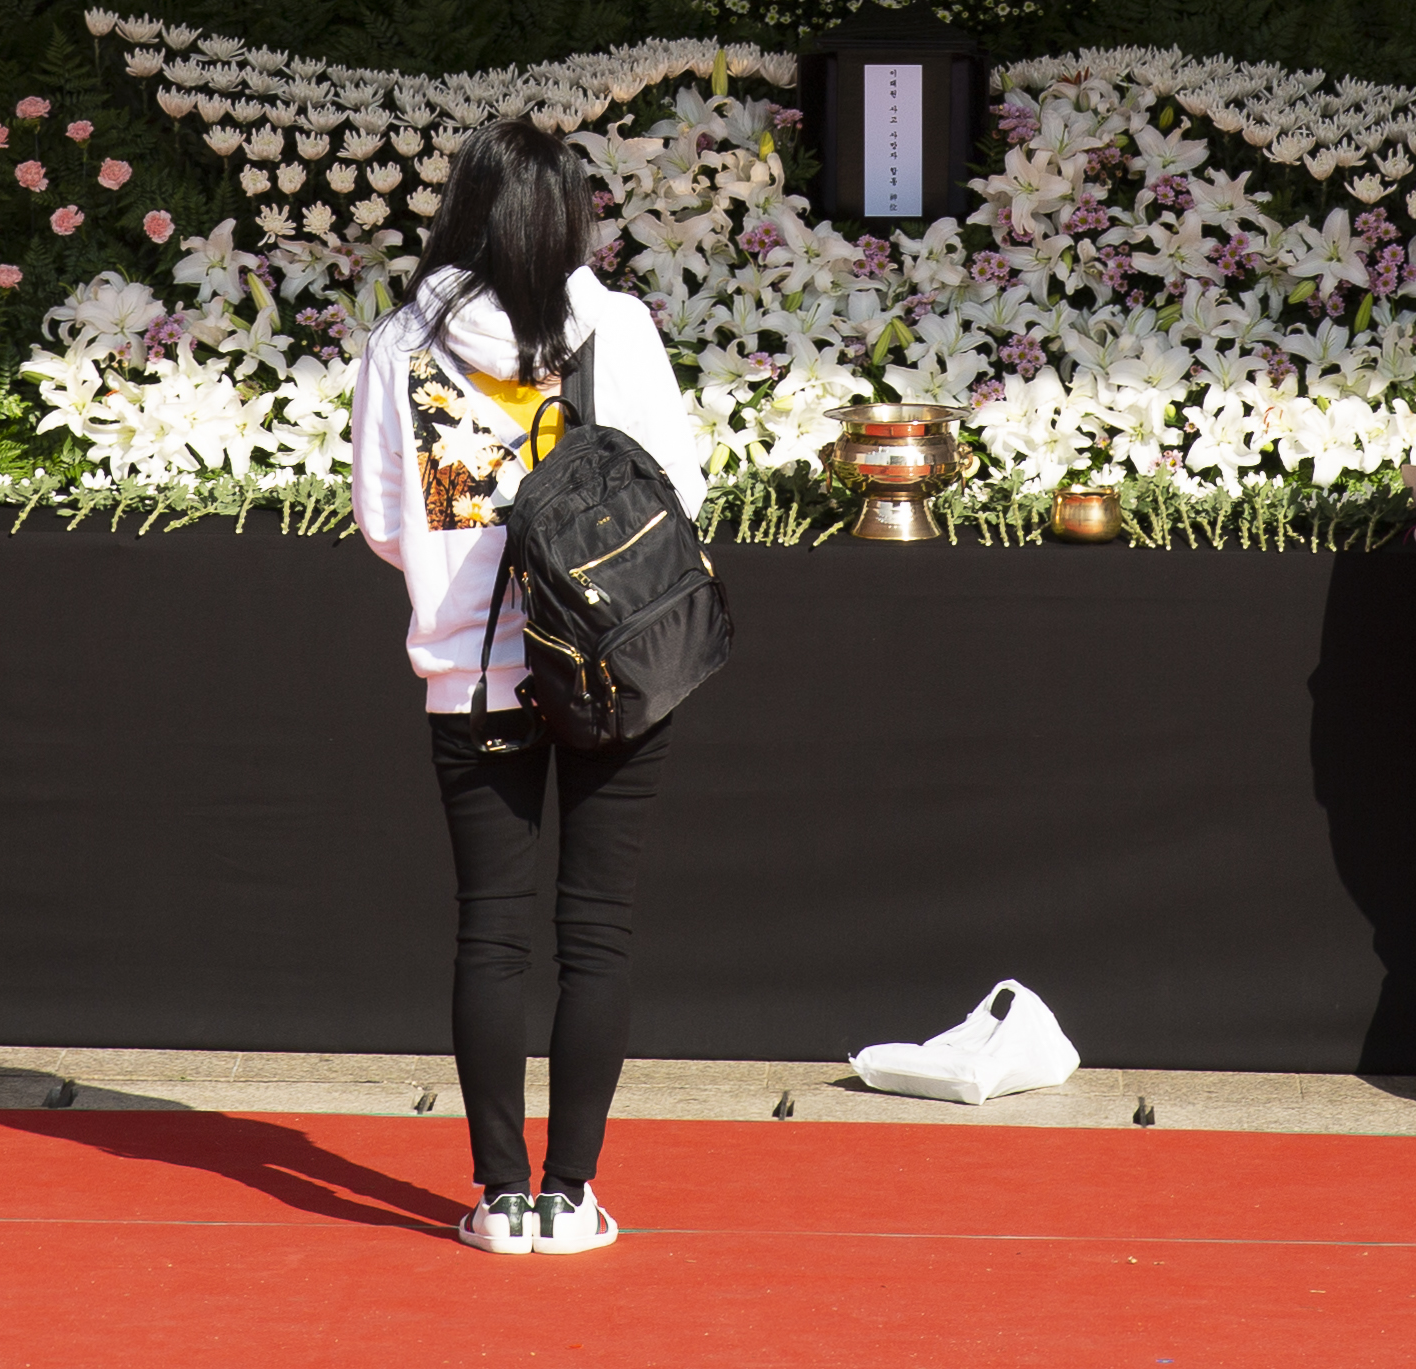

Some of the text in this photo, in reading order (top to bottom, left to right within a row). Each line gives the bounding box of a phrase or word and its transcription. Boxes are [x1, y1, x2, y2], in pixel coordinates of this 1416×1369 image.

[889, 69, 898, 98] 이태원
[889, 105, 898, 124] 사고
[889, 130, 898, 160] 사망자
